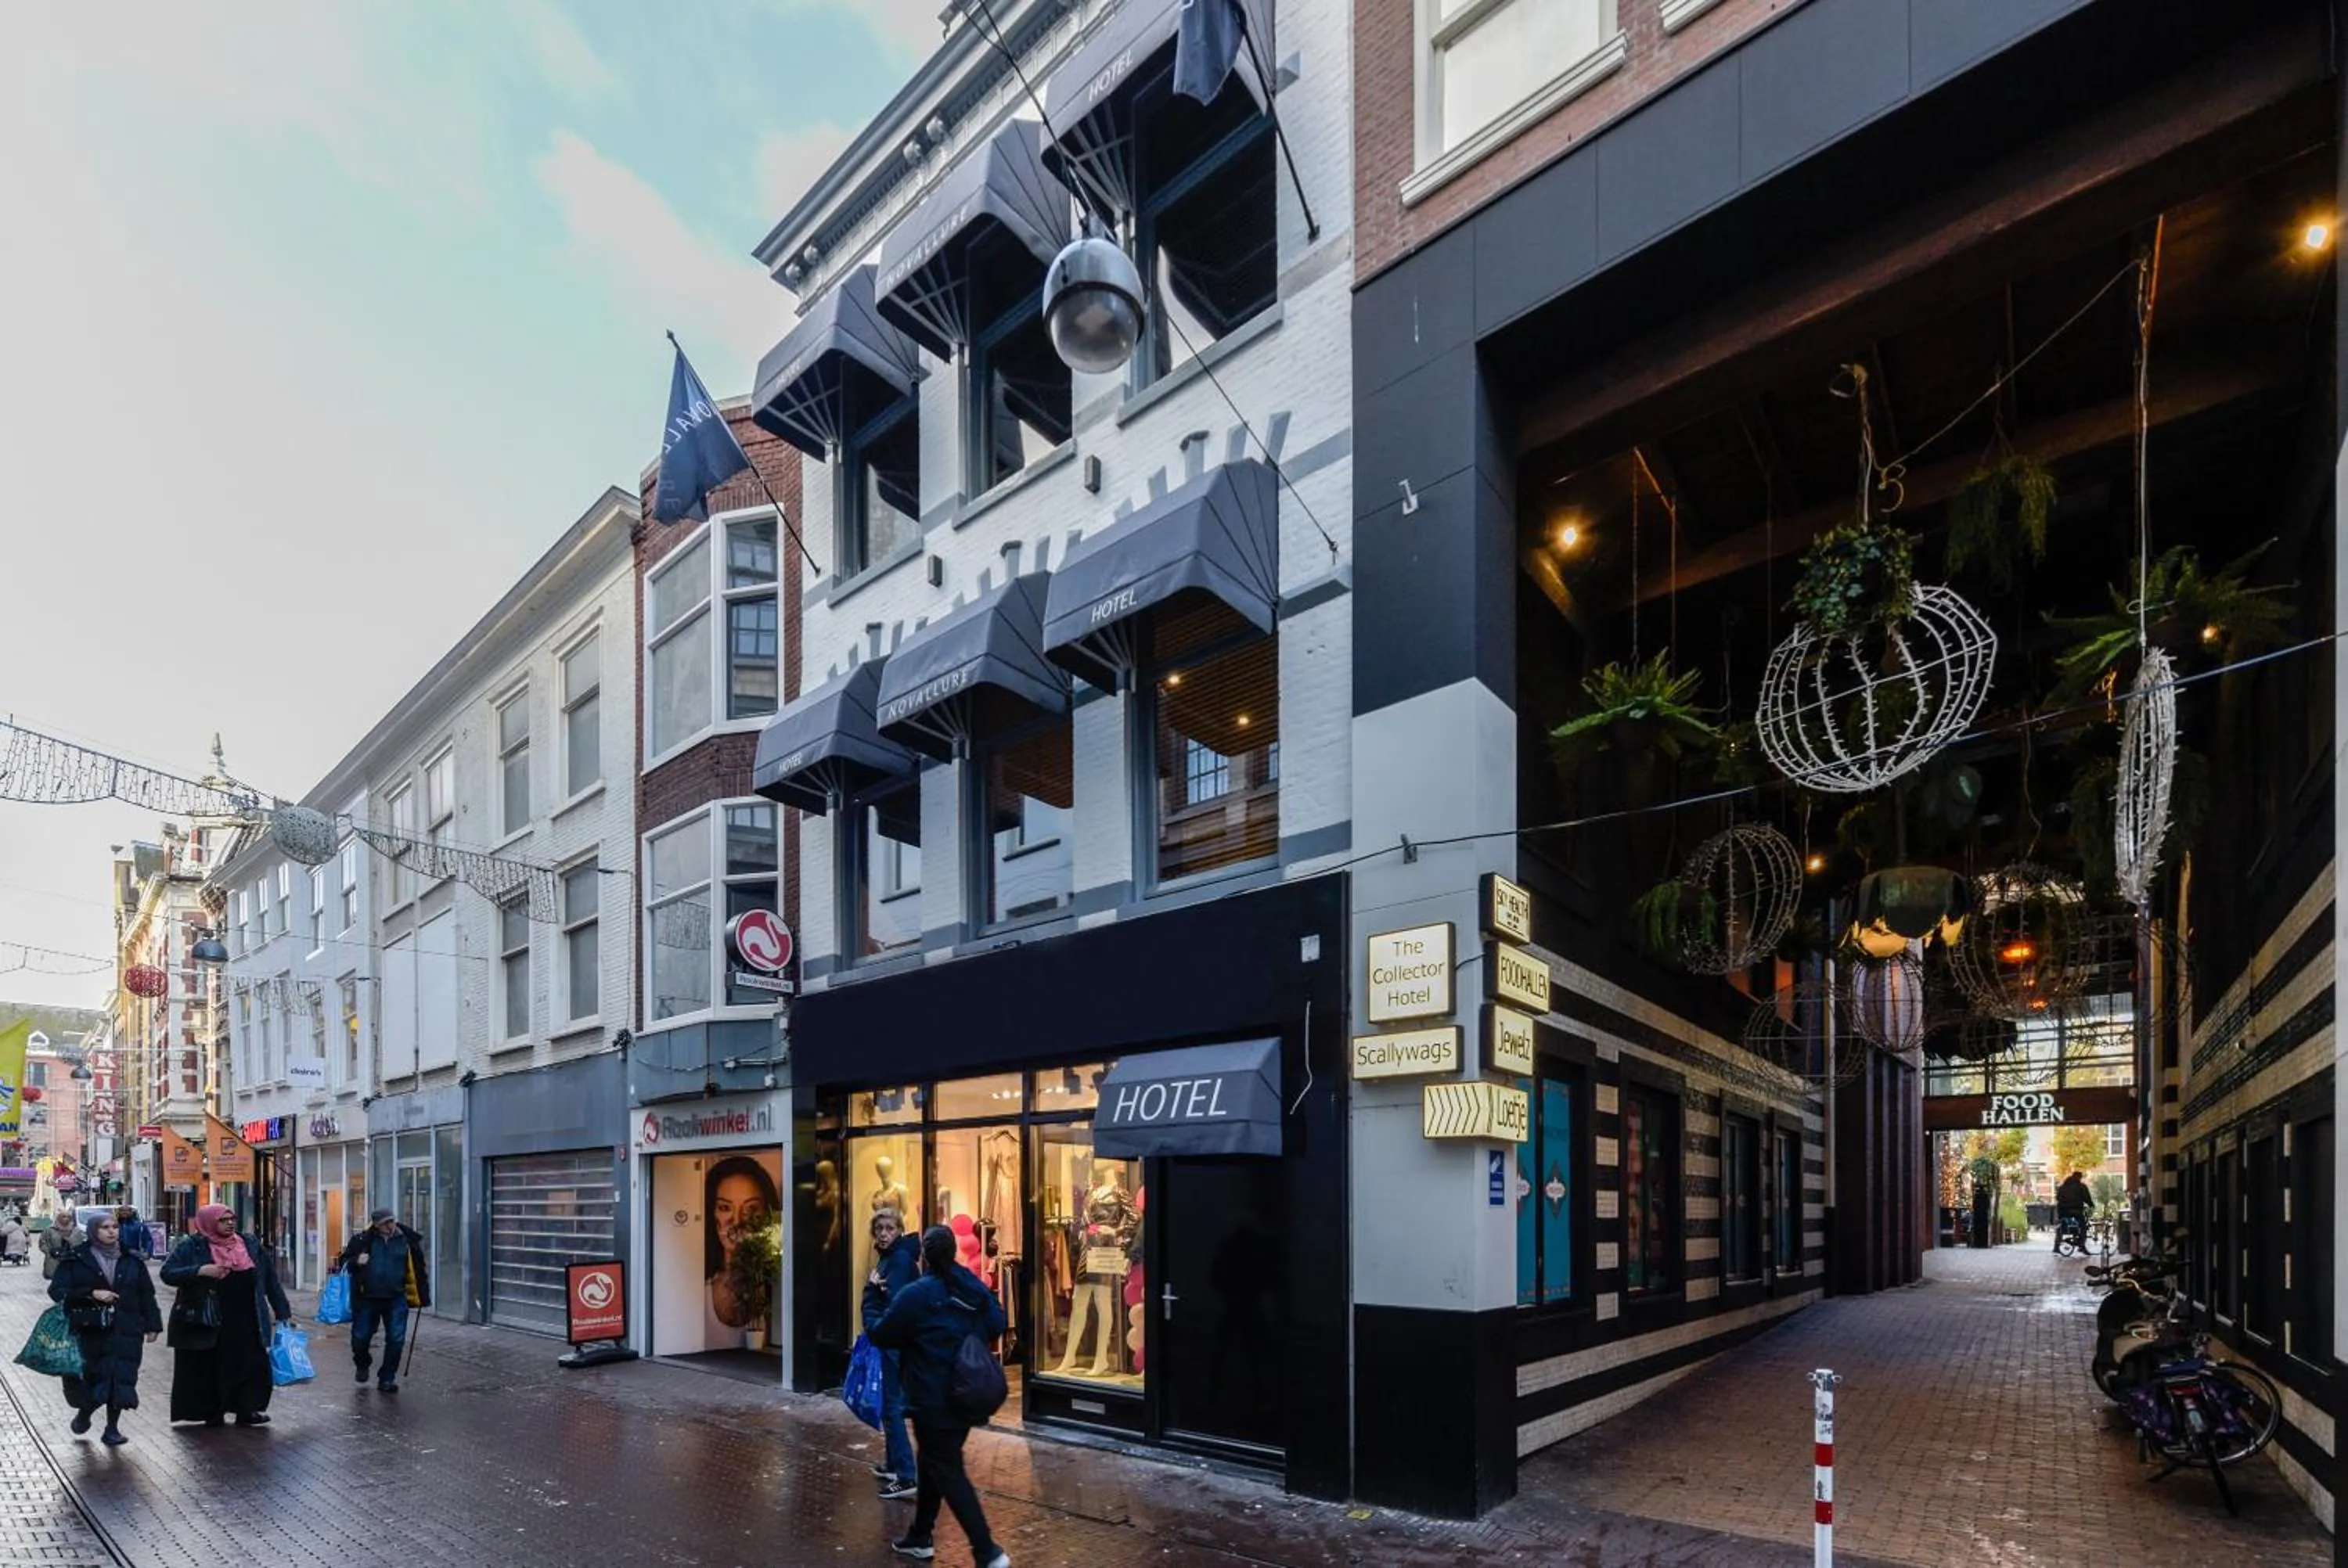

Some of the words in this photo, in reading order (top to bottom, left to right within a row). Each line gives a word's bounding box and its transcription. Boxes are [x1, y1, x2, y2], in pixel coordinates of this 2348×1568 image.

[1089, 49, 1133, 101] HOTEL
[1091, 588, 1137, 624] HOTEL
[888, 670, 967, 719] NOVALLURE
[1392, 940, 1424, 958] The
[1373, 962, 1446, 985] Collector
[1500, 956, 1547, 999] FOODHALLEN
[1388, 985, 1431, 1007] Hotel
[1357, 1041, 1453, 1067] Scallywags
[1498, 1022, 1530, 1060] Jewelz
[1112, 1078, 1226, 1123] HOTEL
[1496, 1089, 1526, 1138] Loetje
[1982, 1106, 2065, 1124] HALLEN
[1990, 1093, 2054, 1110] FOOD
